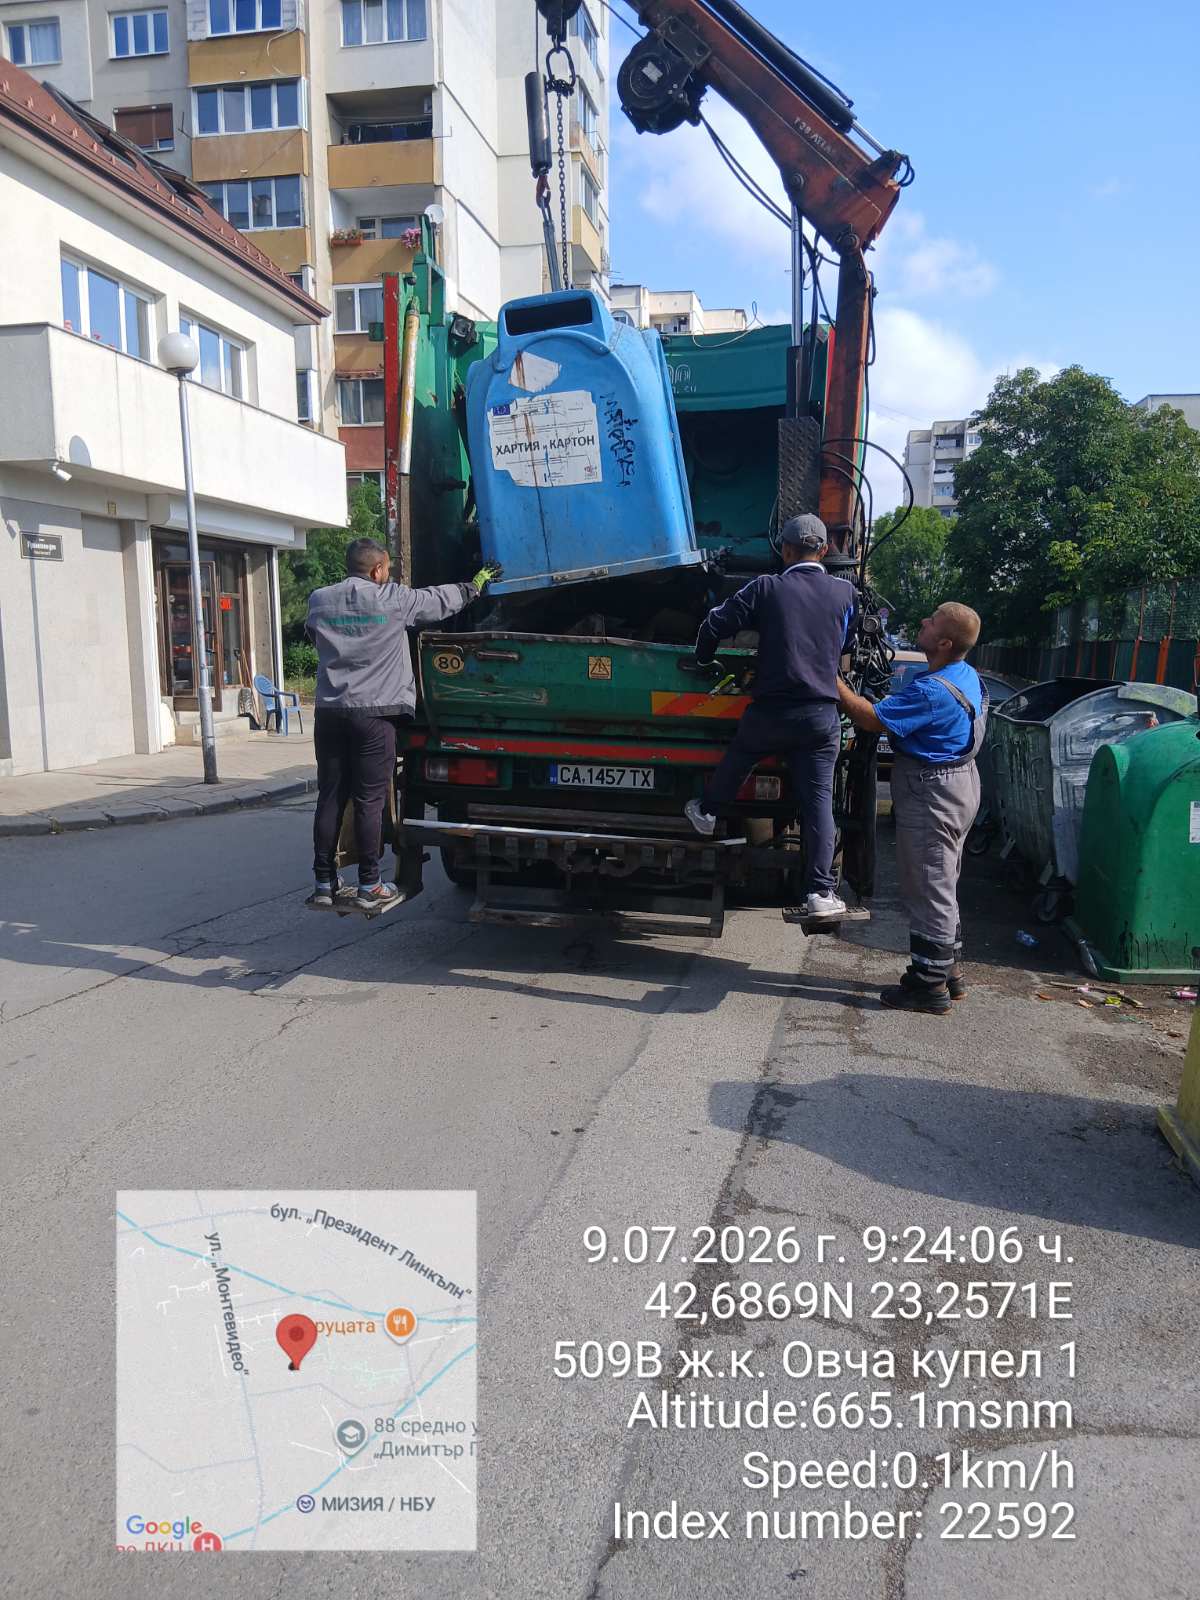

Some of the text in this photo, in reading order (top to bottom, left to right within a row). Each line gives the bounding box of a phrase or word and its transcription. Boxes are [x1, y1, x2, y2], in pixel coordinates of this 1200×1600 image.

[495, 440, 540, 455] ХАРТИЯ
[549, 435, 595, 450] КАРТОН
[438, 656, 461, 669] 80
[629, 770, 652, 787] TX
